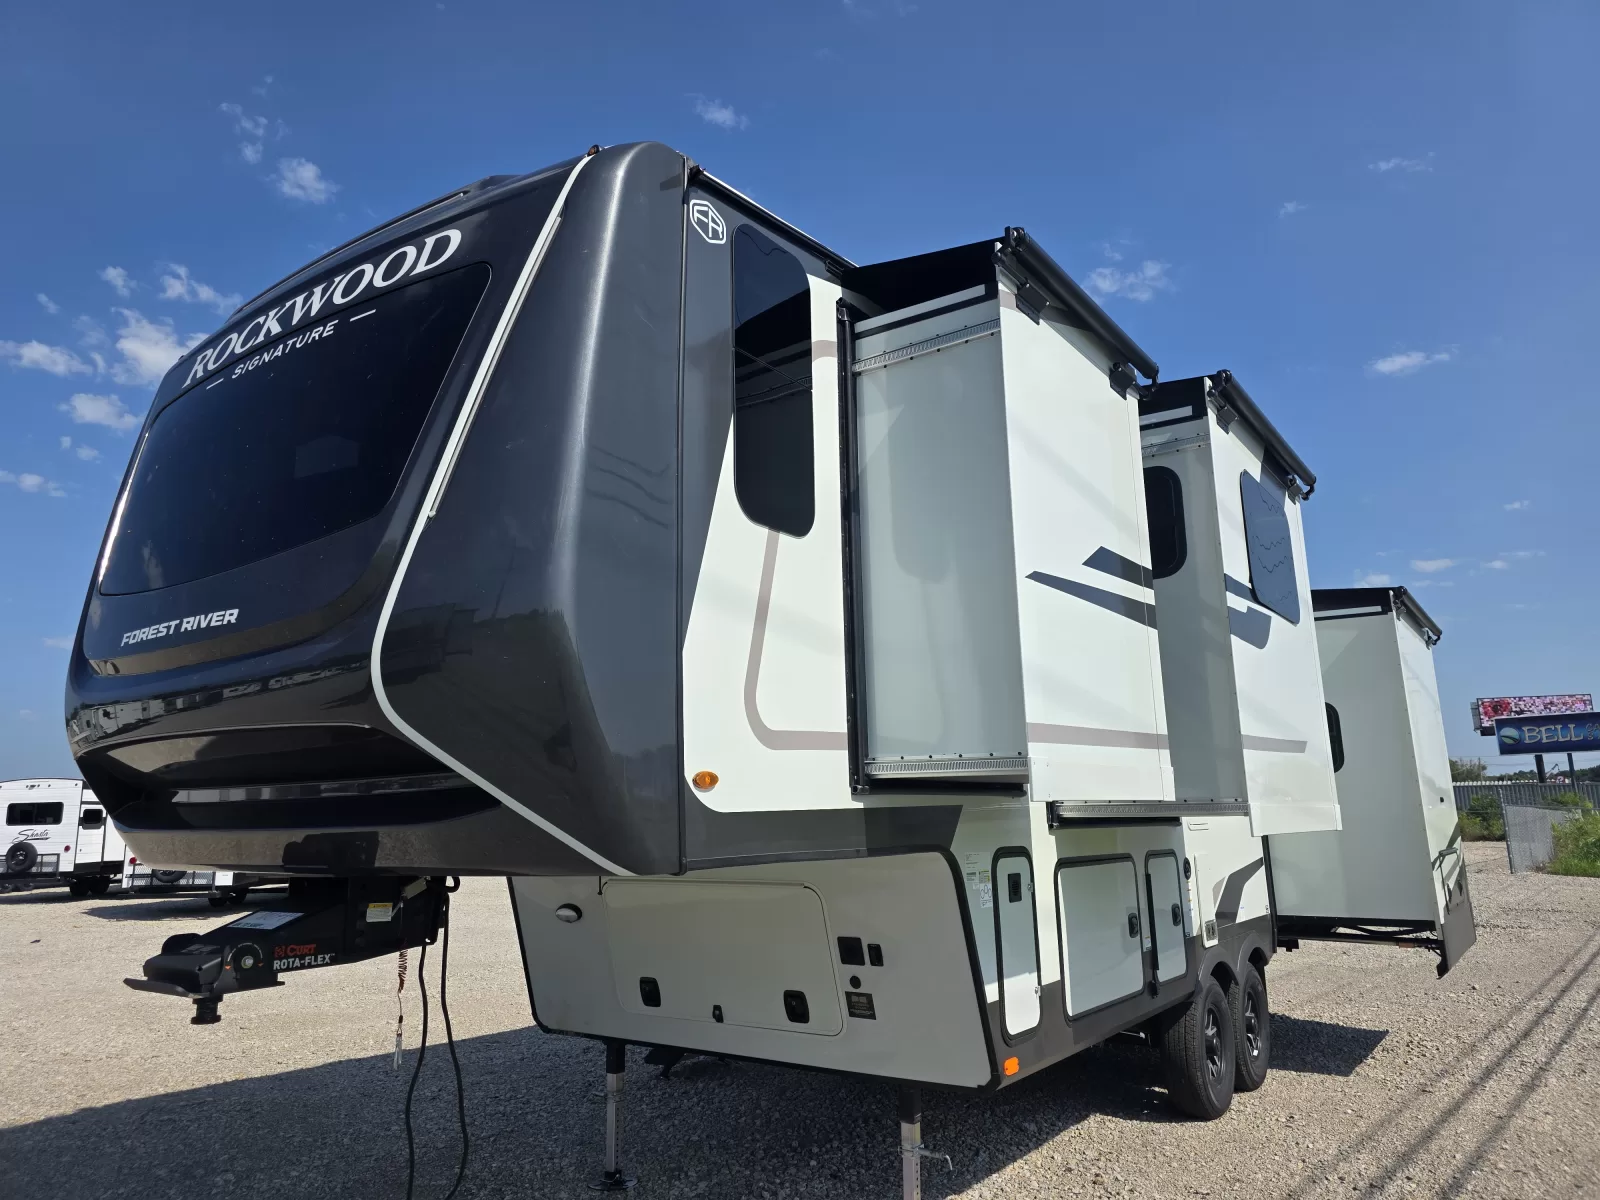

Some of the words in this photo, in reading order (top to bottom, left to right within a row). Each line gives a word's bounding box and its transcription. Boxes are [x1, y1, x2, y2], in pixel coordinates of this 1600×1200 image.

[182, 229, 462, 388] ROCKWOOD
[231, 320, 338, 379] SIGNATURE
[120, 619, 180, 647] FOREST
[180, 608, 239, 633] RIVER
[1522, 724, 1584, 743] BELL
